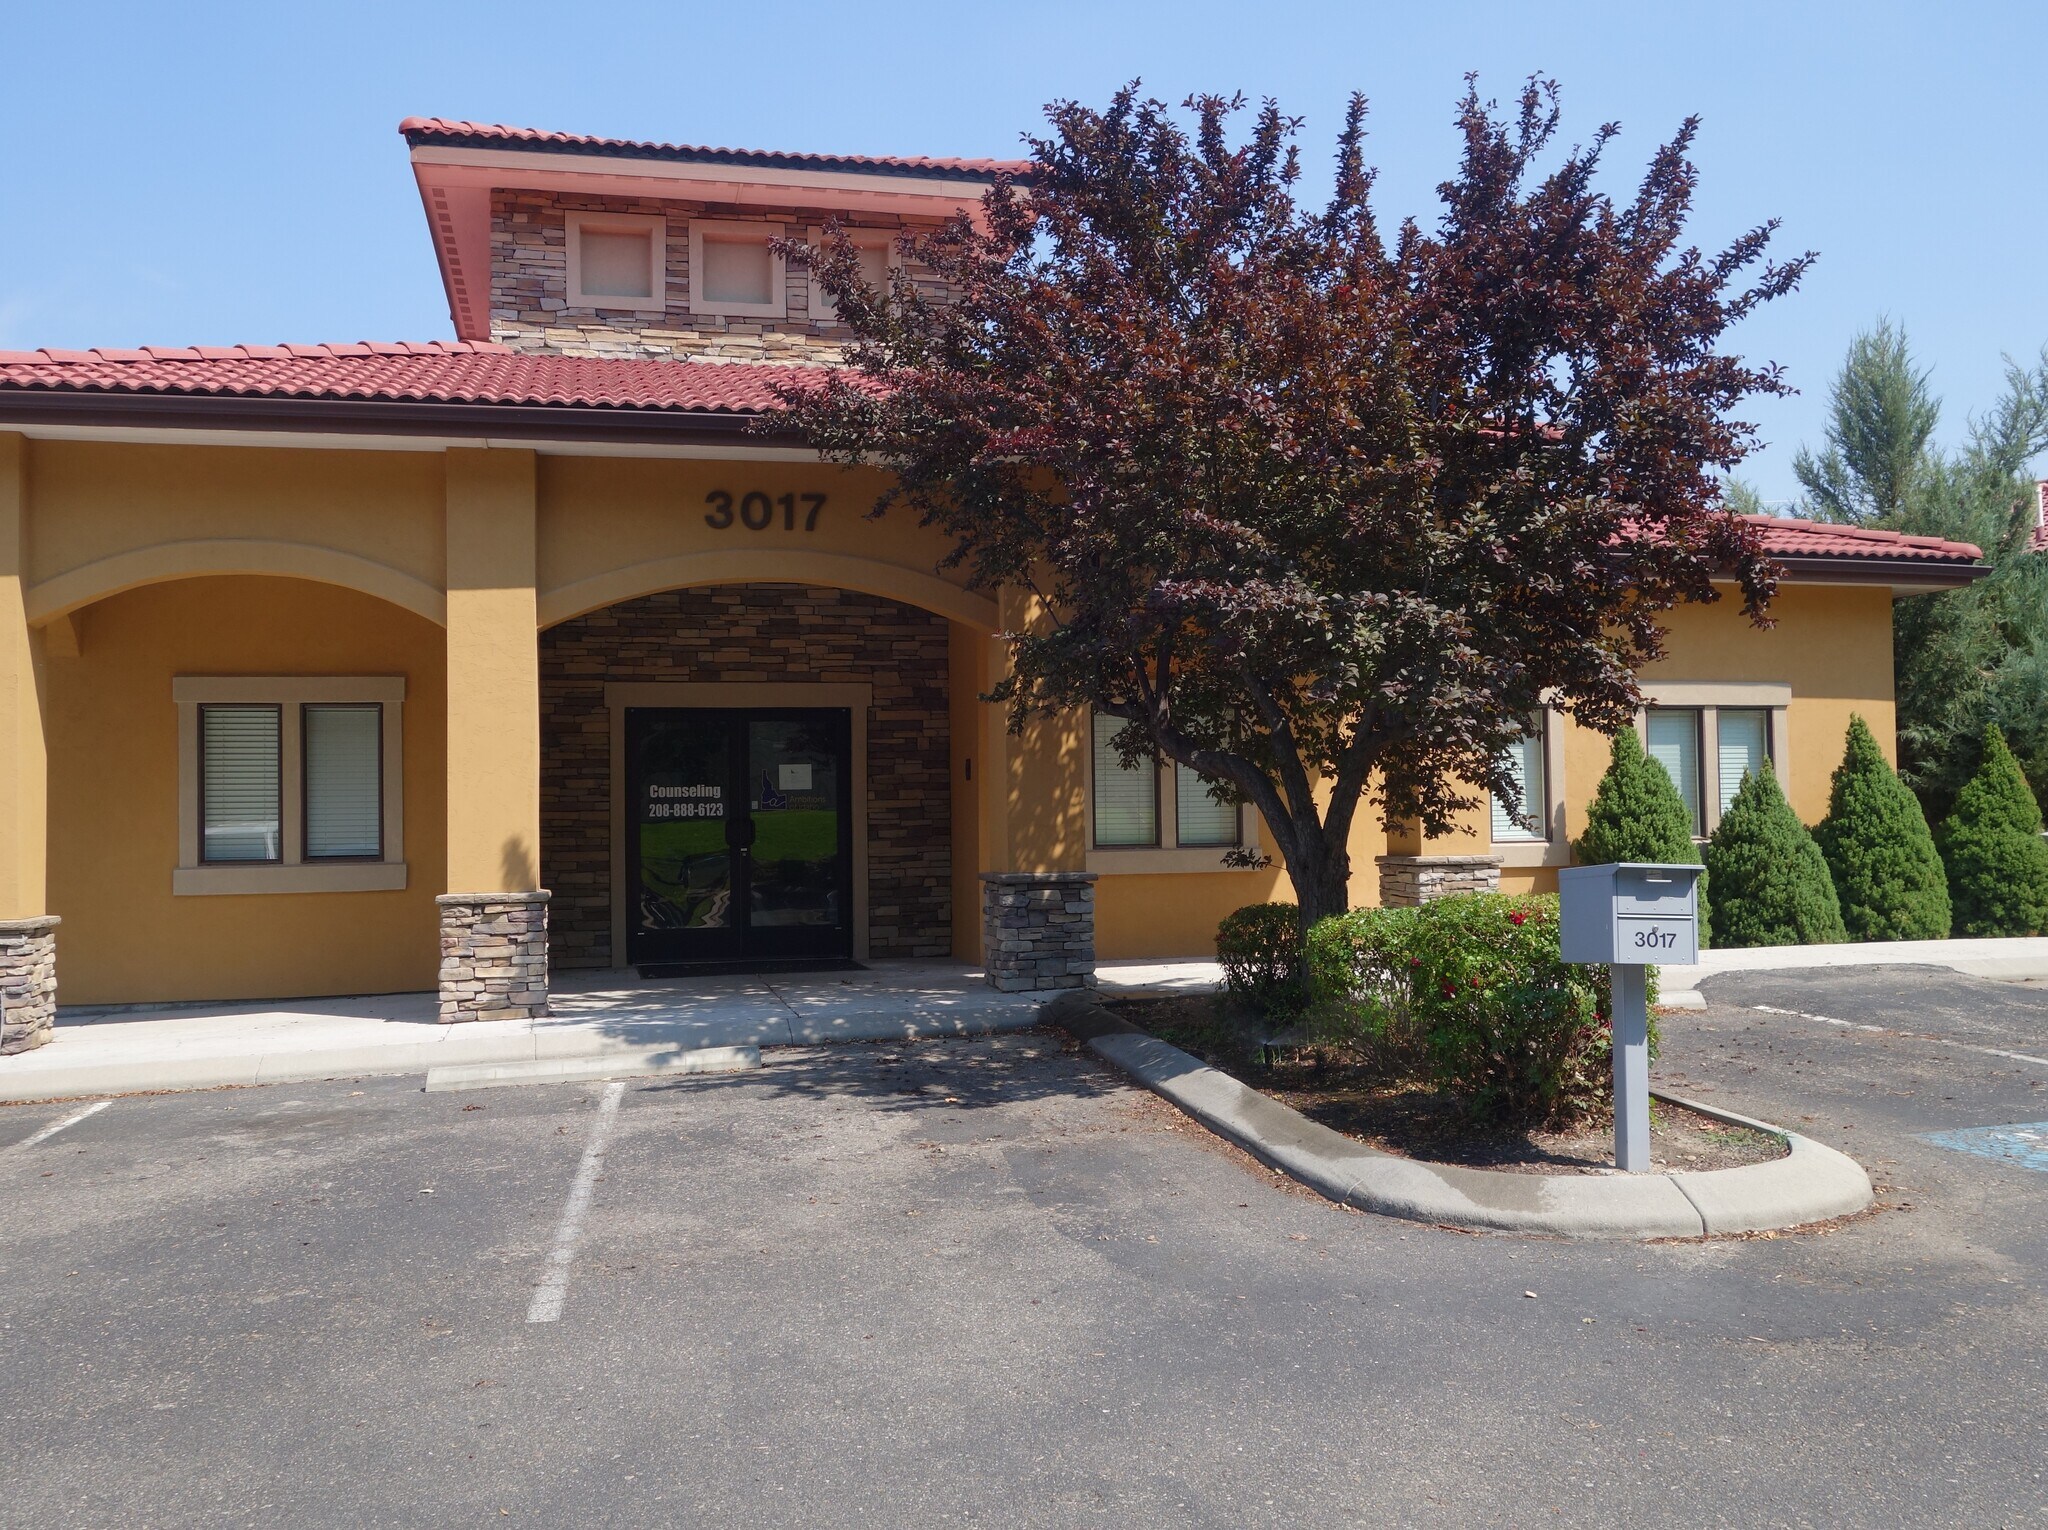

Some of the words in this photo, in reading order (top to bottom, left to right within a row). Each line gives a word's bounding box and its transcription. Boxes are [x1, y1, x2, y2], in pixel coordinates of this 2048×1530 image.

[704, 490, 828, 532] 3017
[649, 784, 721, 799] Counseling
[648, 803, 724, 817] 208-888-6123
[1634, 931, 1677, 948] 3017
